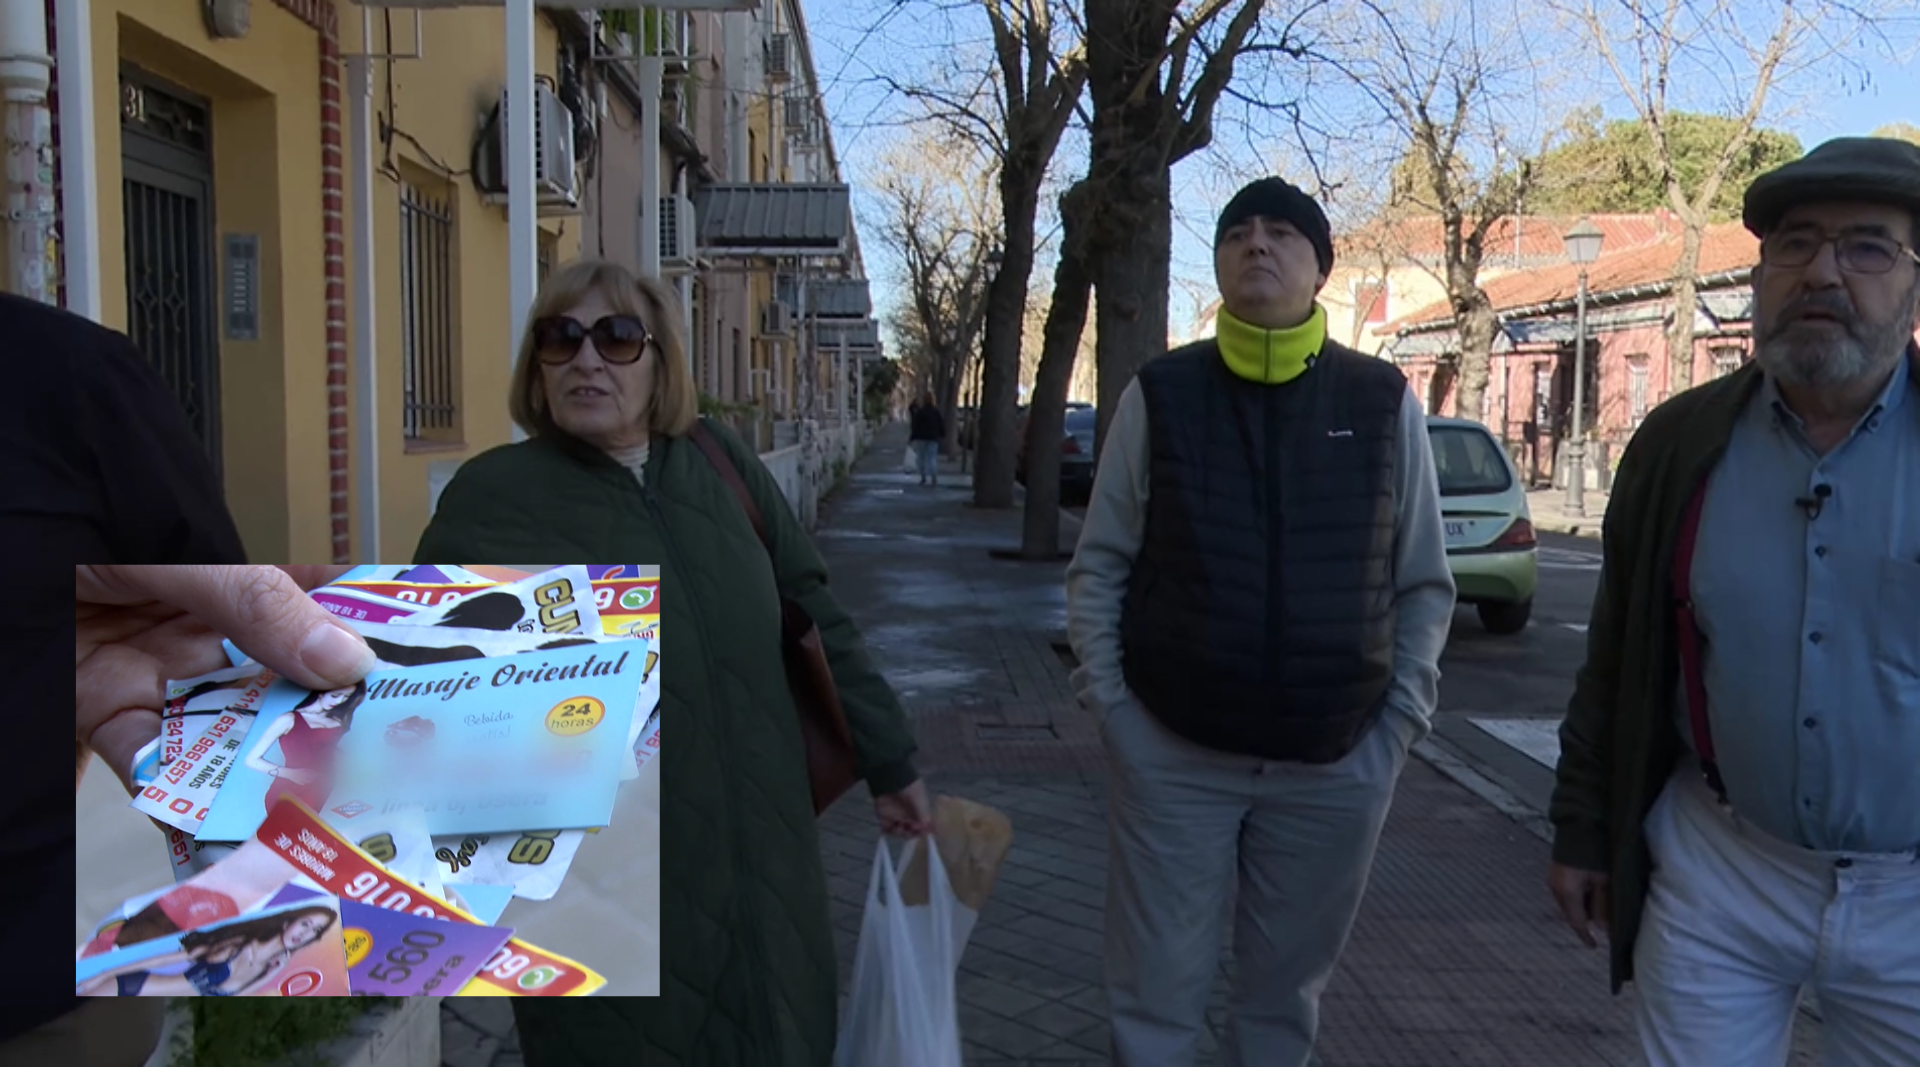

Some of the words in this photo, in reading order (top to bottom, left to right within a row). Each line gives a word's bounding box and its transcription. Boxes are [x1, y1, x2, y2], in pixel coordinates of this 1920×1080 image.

[124, 86, 146, 122] 31
[366, 671, 481, 701] Masaje
[491, 651, 629, 687] Oriental
[464, 710, 513, 727] Bebida
[561, 703, 591, 717] 24
[208, 715, 236, 738] 631
[551, 718, 594, 729] horas
[185, 736, 216, 761] 966
[222, 738, 241, 753] DE
[165, 759, 194, 785] 257
[210, 754, 227, 767] 18
[188, 764, 216, 789] AÑOS
